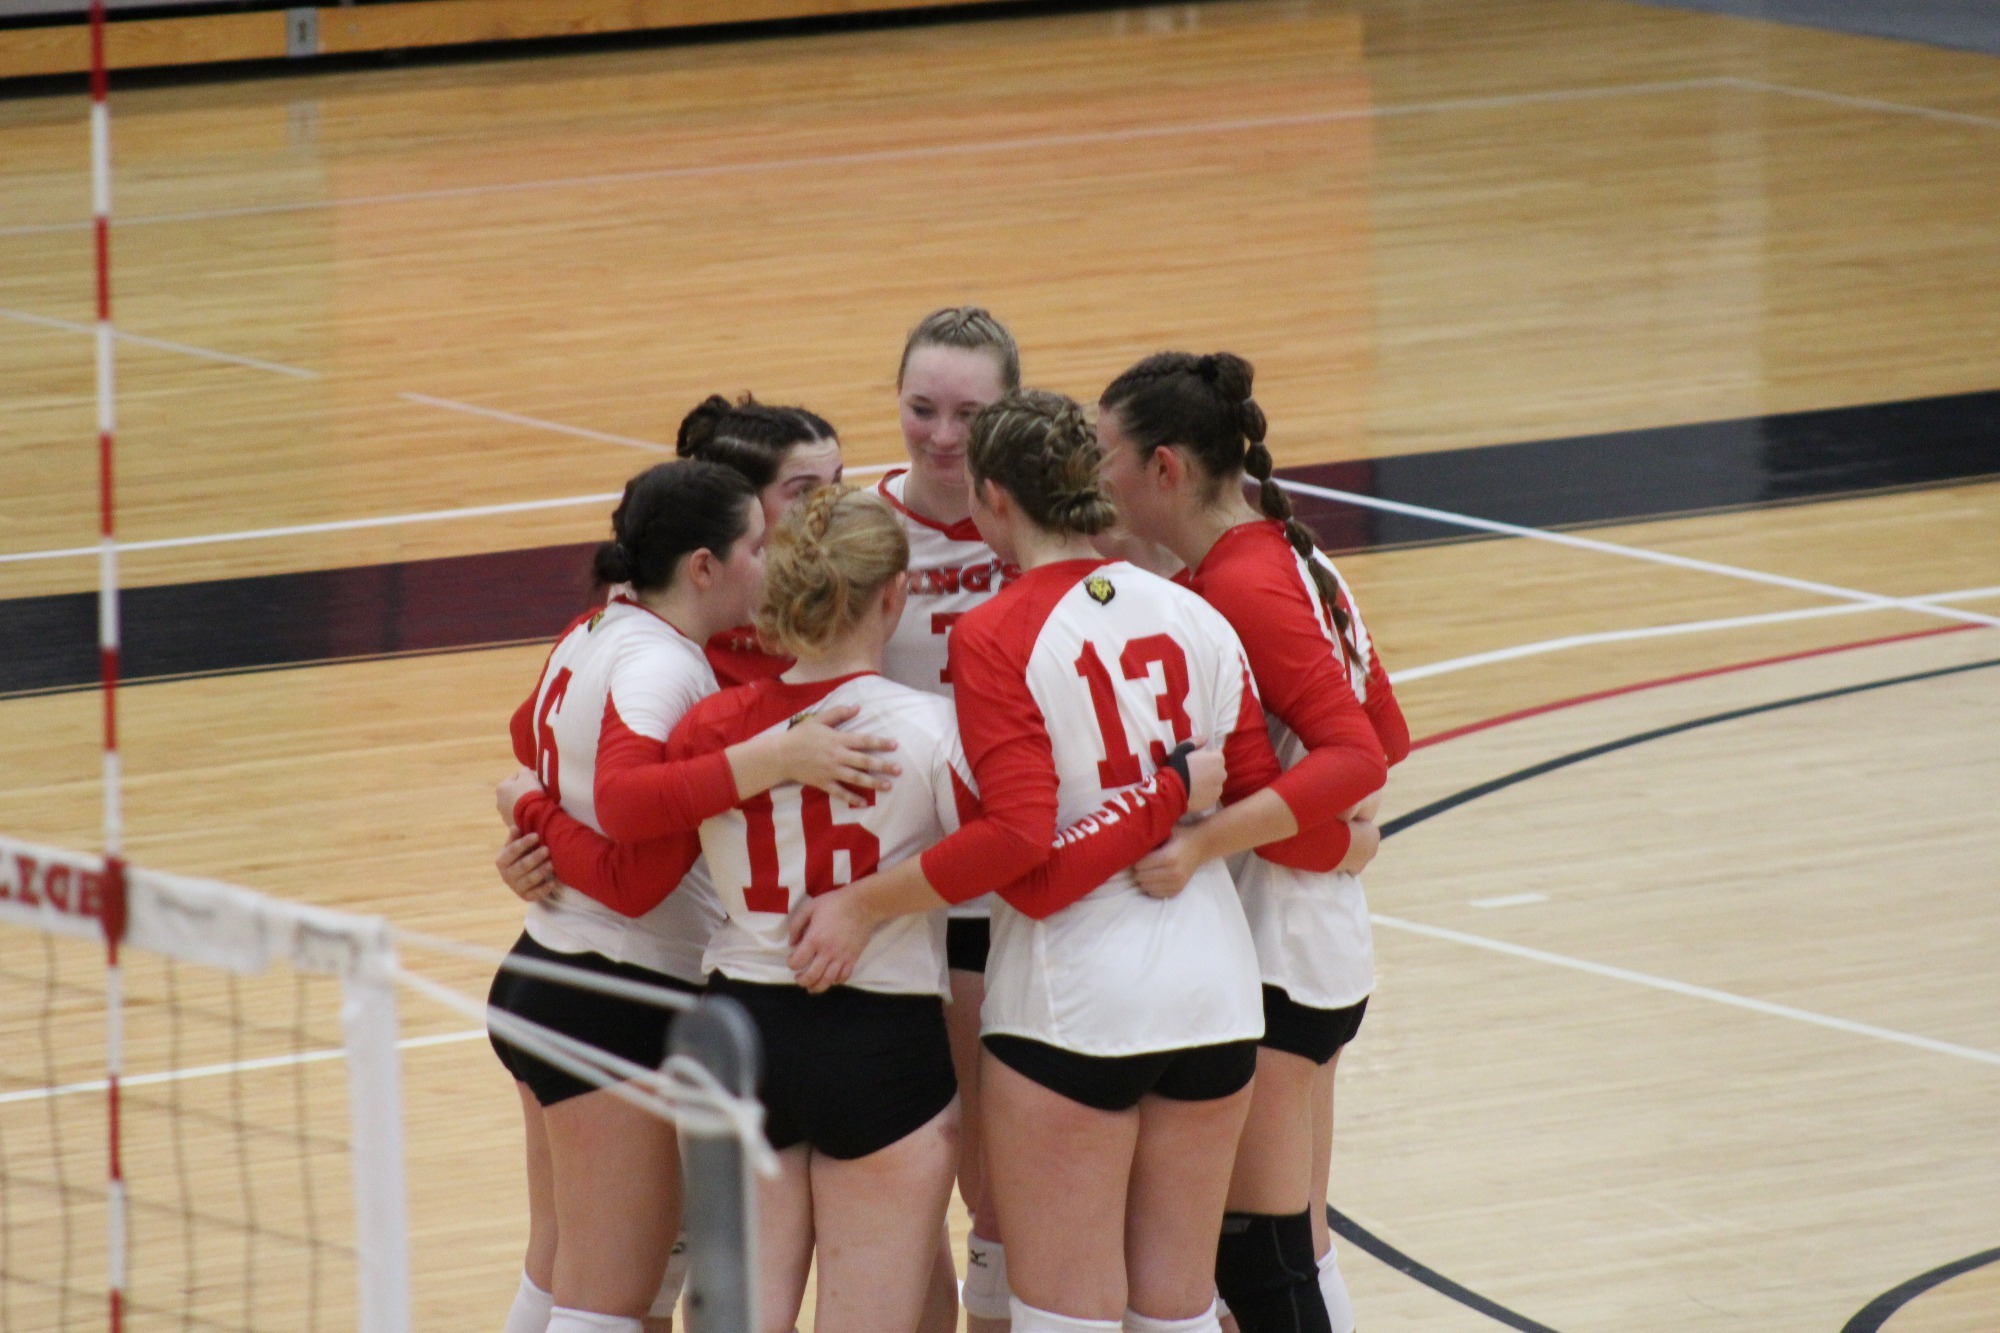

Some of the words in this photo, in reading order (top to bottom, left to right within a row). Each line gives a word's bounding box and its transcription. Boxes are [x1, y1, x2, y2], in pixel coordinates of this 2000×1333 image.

[907, 558, 1022, 595] ING'S
[538, 666, 573, 804] 6
[1074, 632, 1192, 790] 13
[733, 776, 880, 914] 16
